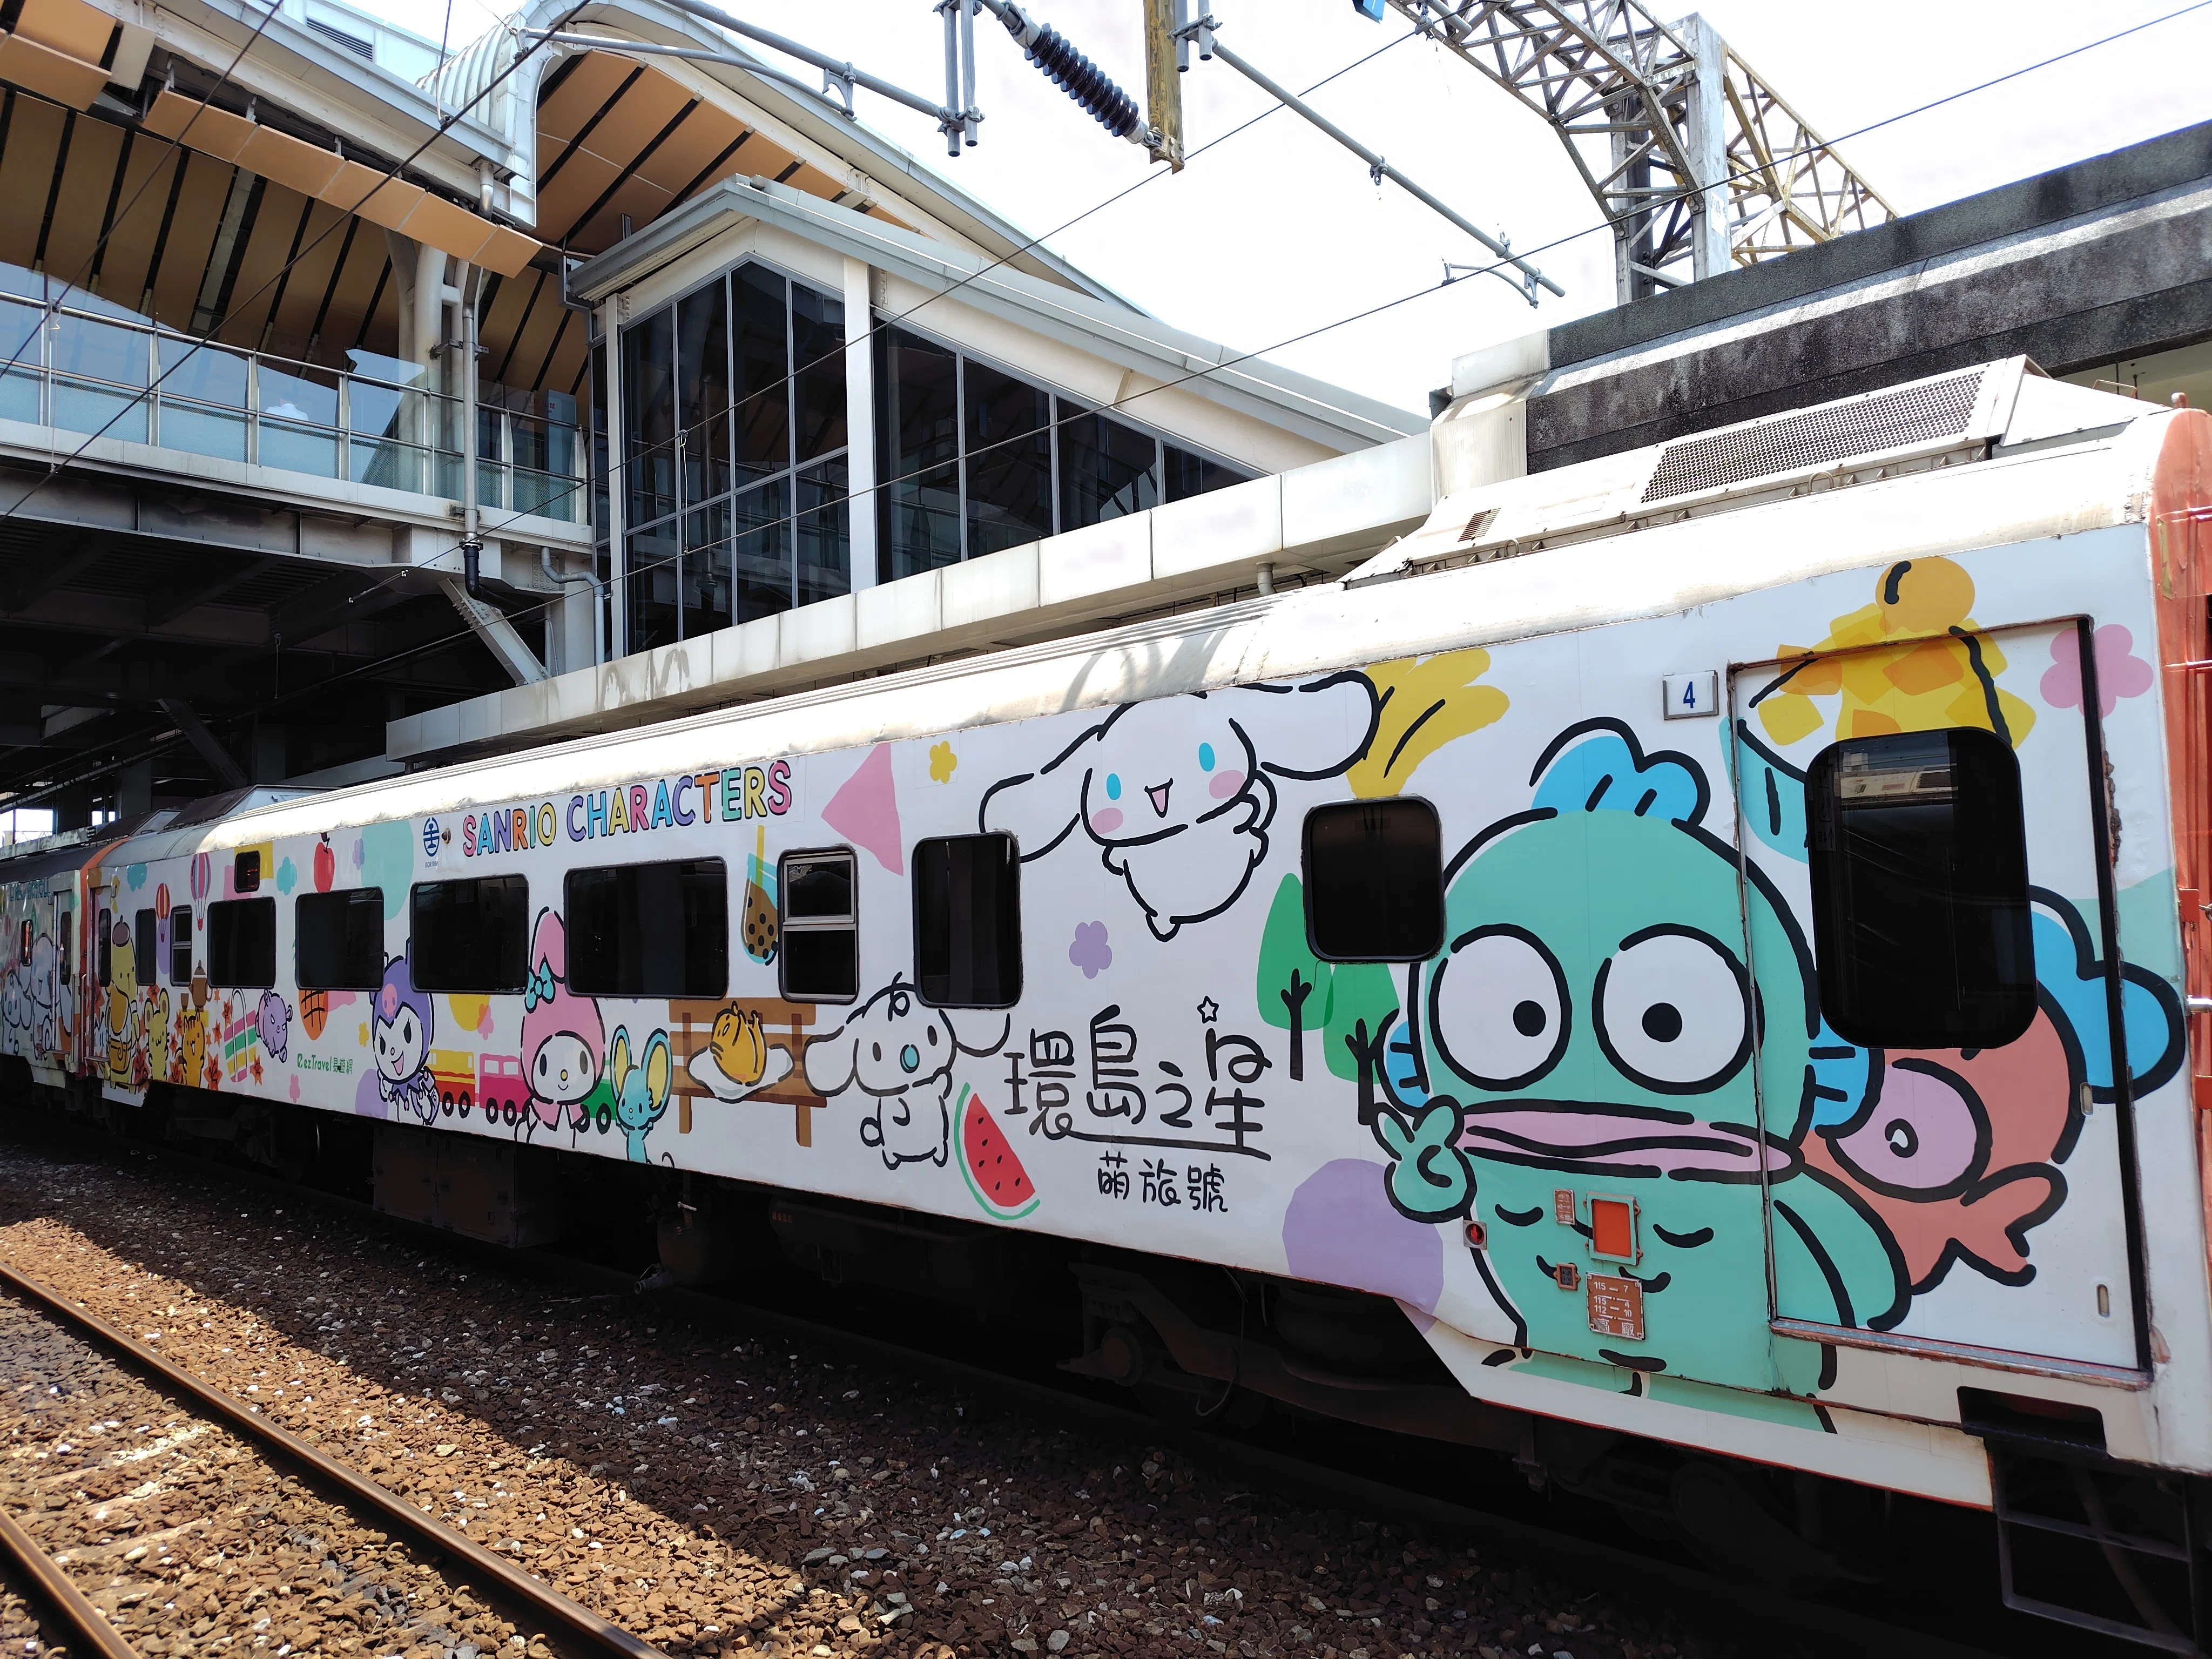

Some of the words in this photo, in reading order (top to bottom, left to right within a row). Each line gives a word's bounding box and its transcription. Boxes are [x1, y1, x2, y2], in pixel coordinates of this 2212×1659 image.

[1683, 681, 1695, 709] 4
[462, 802, 556, 857] SANRIO
[567, 759, 792, 842] CHARACTERS
[1004, 997, 1272, 1161] 環島之星
[1098, 1150, 1228, 1212] 萌旅號
[1594, 1281, 1606, 1291] 115
[1623, 1285, 1629, 1293] 7
[1594, 1296, 1607, 1306] 115
[1594, 1305, 1607, 1314] 112
[1623, 1309, 1632, 1317] 10
